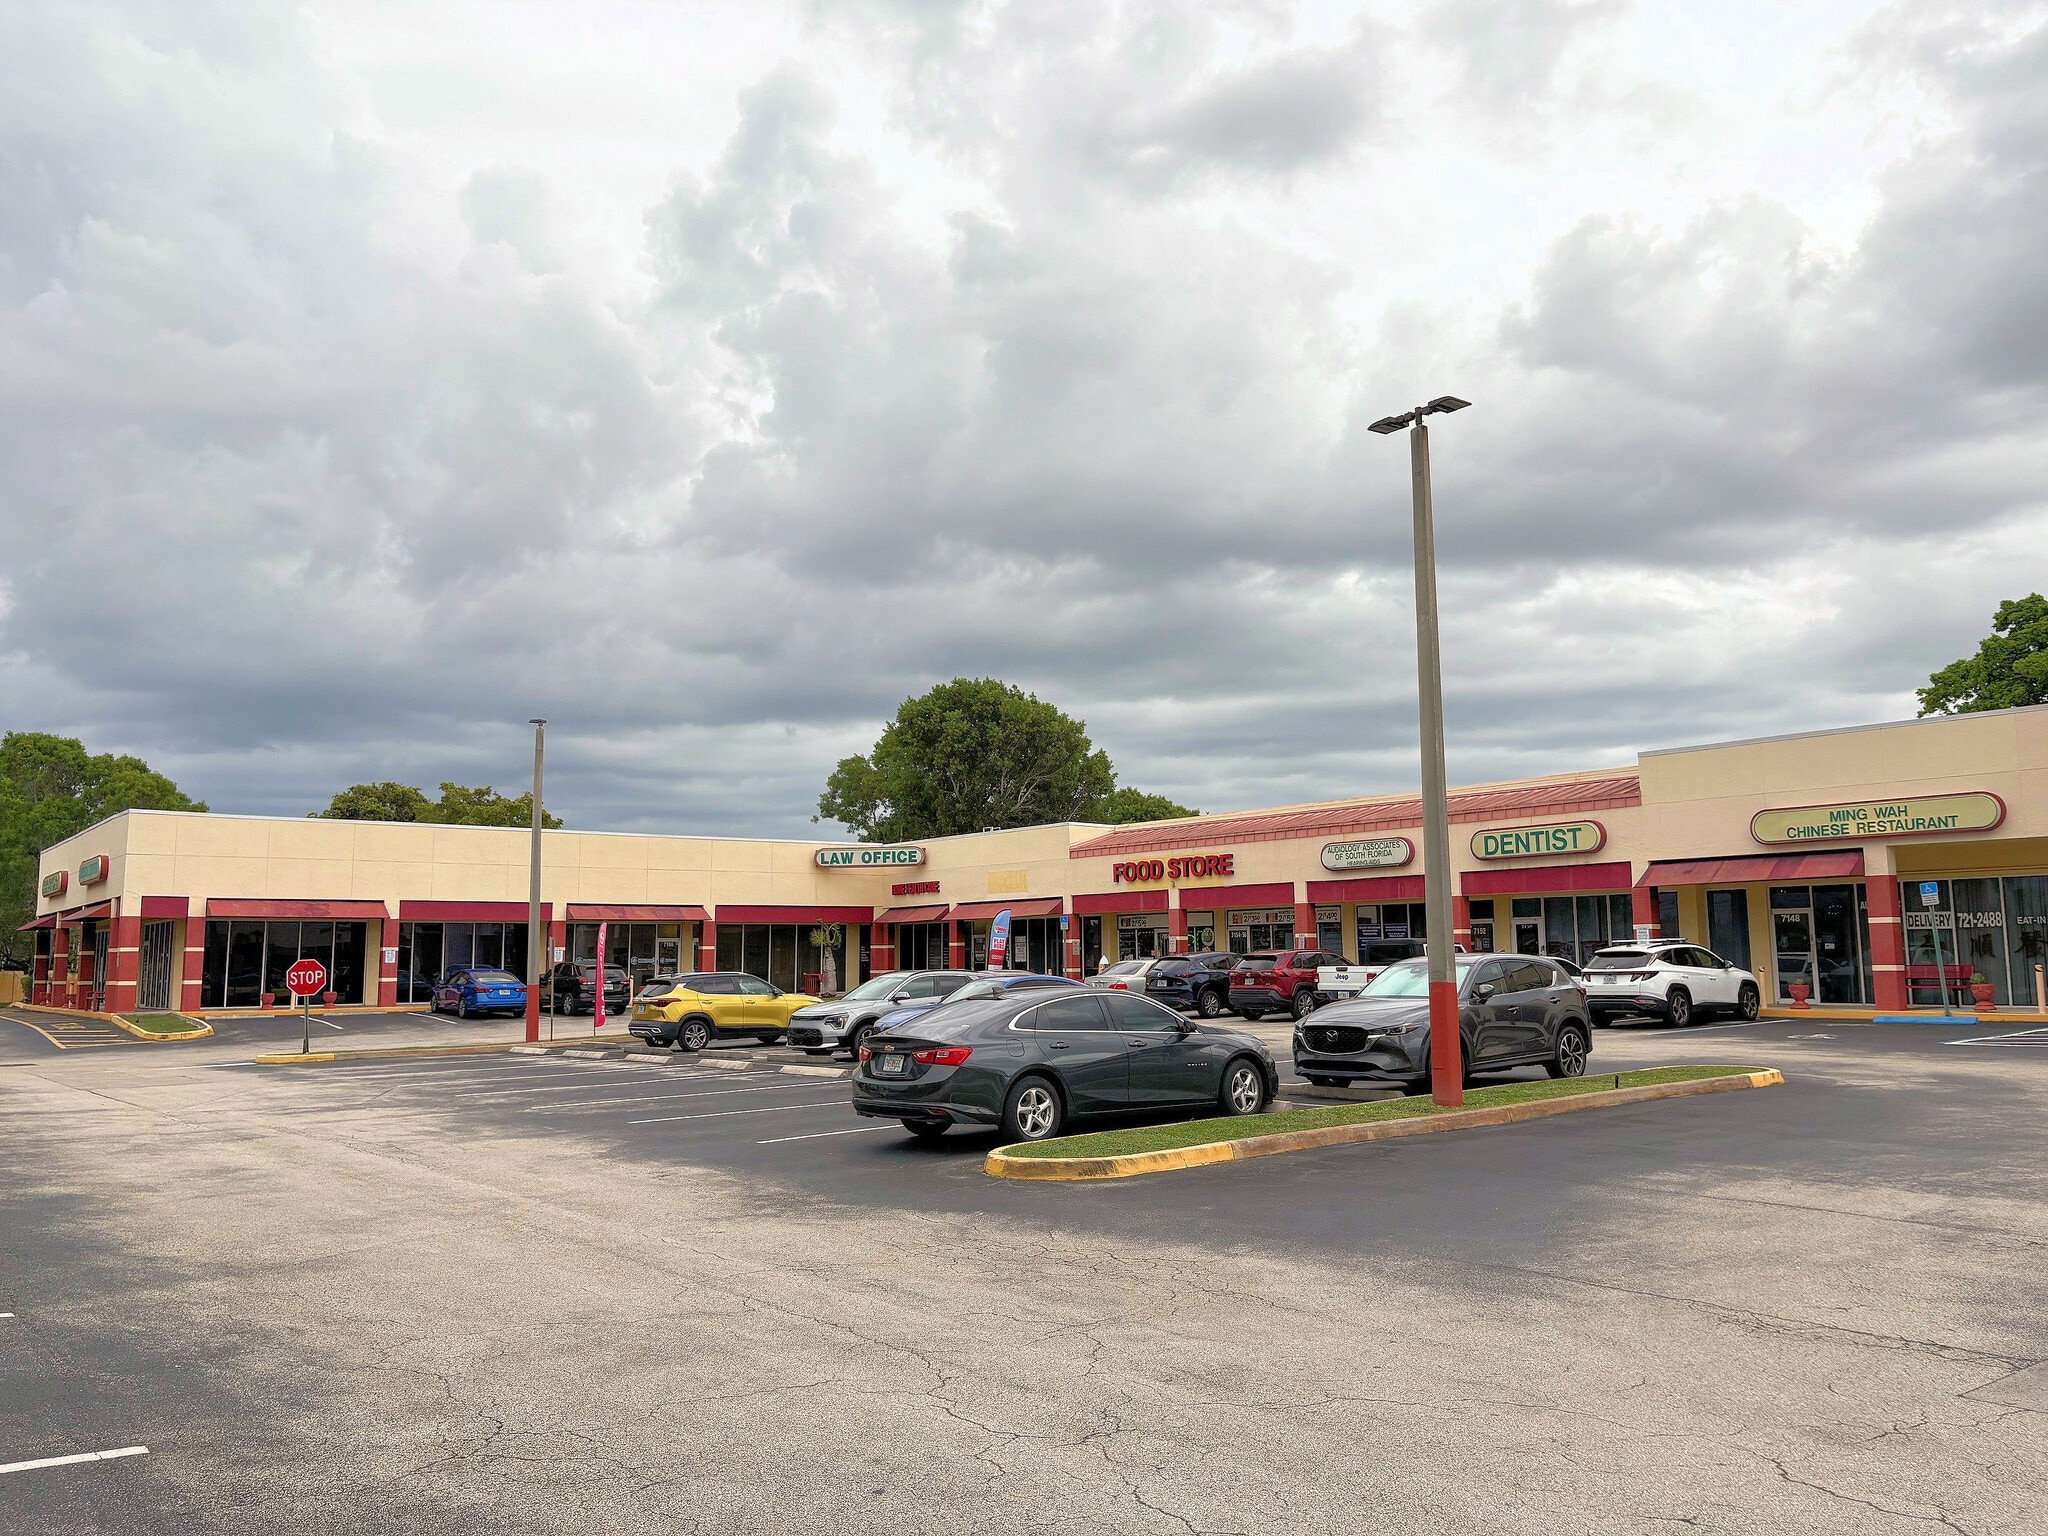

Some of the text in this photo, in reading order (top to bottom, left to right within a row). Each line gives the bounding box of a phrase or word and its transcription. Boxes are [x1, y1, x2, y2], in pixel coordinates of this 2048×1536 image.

[1829, 805, 1908, 823] MING WAH
[1786, 815, 1959, 839] CHINESE RESTAURANT
[1327, 841, 1400, 854] AUDIOLOGY ASSOCIATES
[1483, 827, 1582, 856] DENTIST
[820, 850, 918, 865] LAW OFFICE
[1334, 849, 1393, 861] OF SOUTH FLORIDA
[1112, 853, 1234, 883] FOOD STORE
[1780, 914, 1801, 923] 7148
[1957, 911, 2003, 928] 721-2488
[2016, 915, 2047, 925] EAT-IN
[1473, 927, 1487, 935] 7152
[289, 970, 324, 986] STOP
[1335, 973, 1349, 981] Jeep
